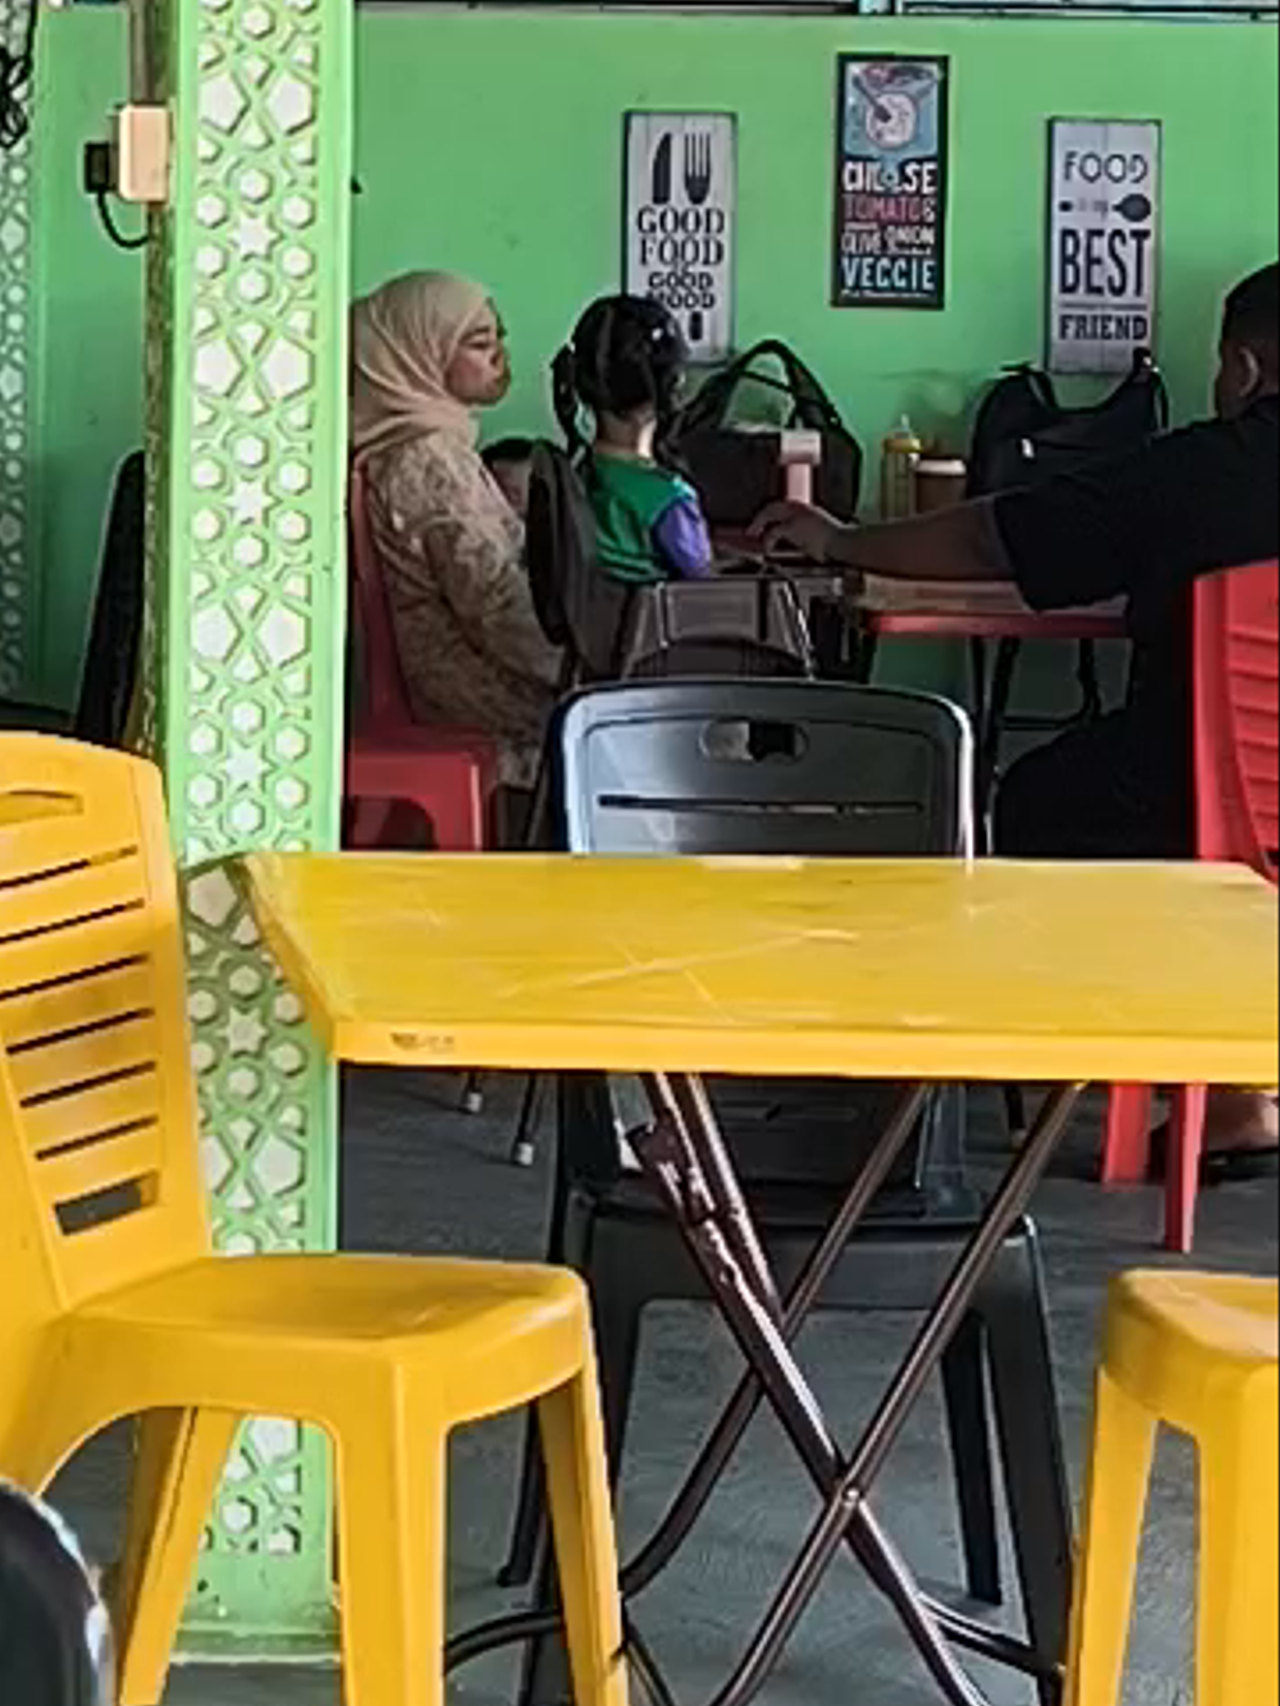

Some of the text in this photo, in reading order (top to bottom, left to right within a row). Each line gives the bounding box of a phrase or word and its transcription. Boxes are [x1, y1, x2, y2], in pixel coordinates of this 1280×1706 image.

[1064, 151, 1148, 183] FOOD
[638, 205, 724, 234] GOOD
[843, 194, 920, 220] TOMATO
[641, 235, 724, 266] FOOD
[1059, 228, 1151, 297] BEST
[648, 271, 714, 290] GOOD
[1059, 313, 1148, 340] FRIEND
